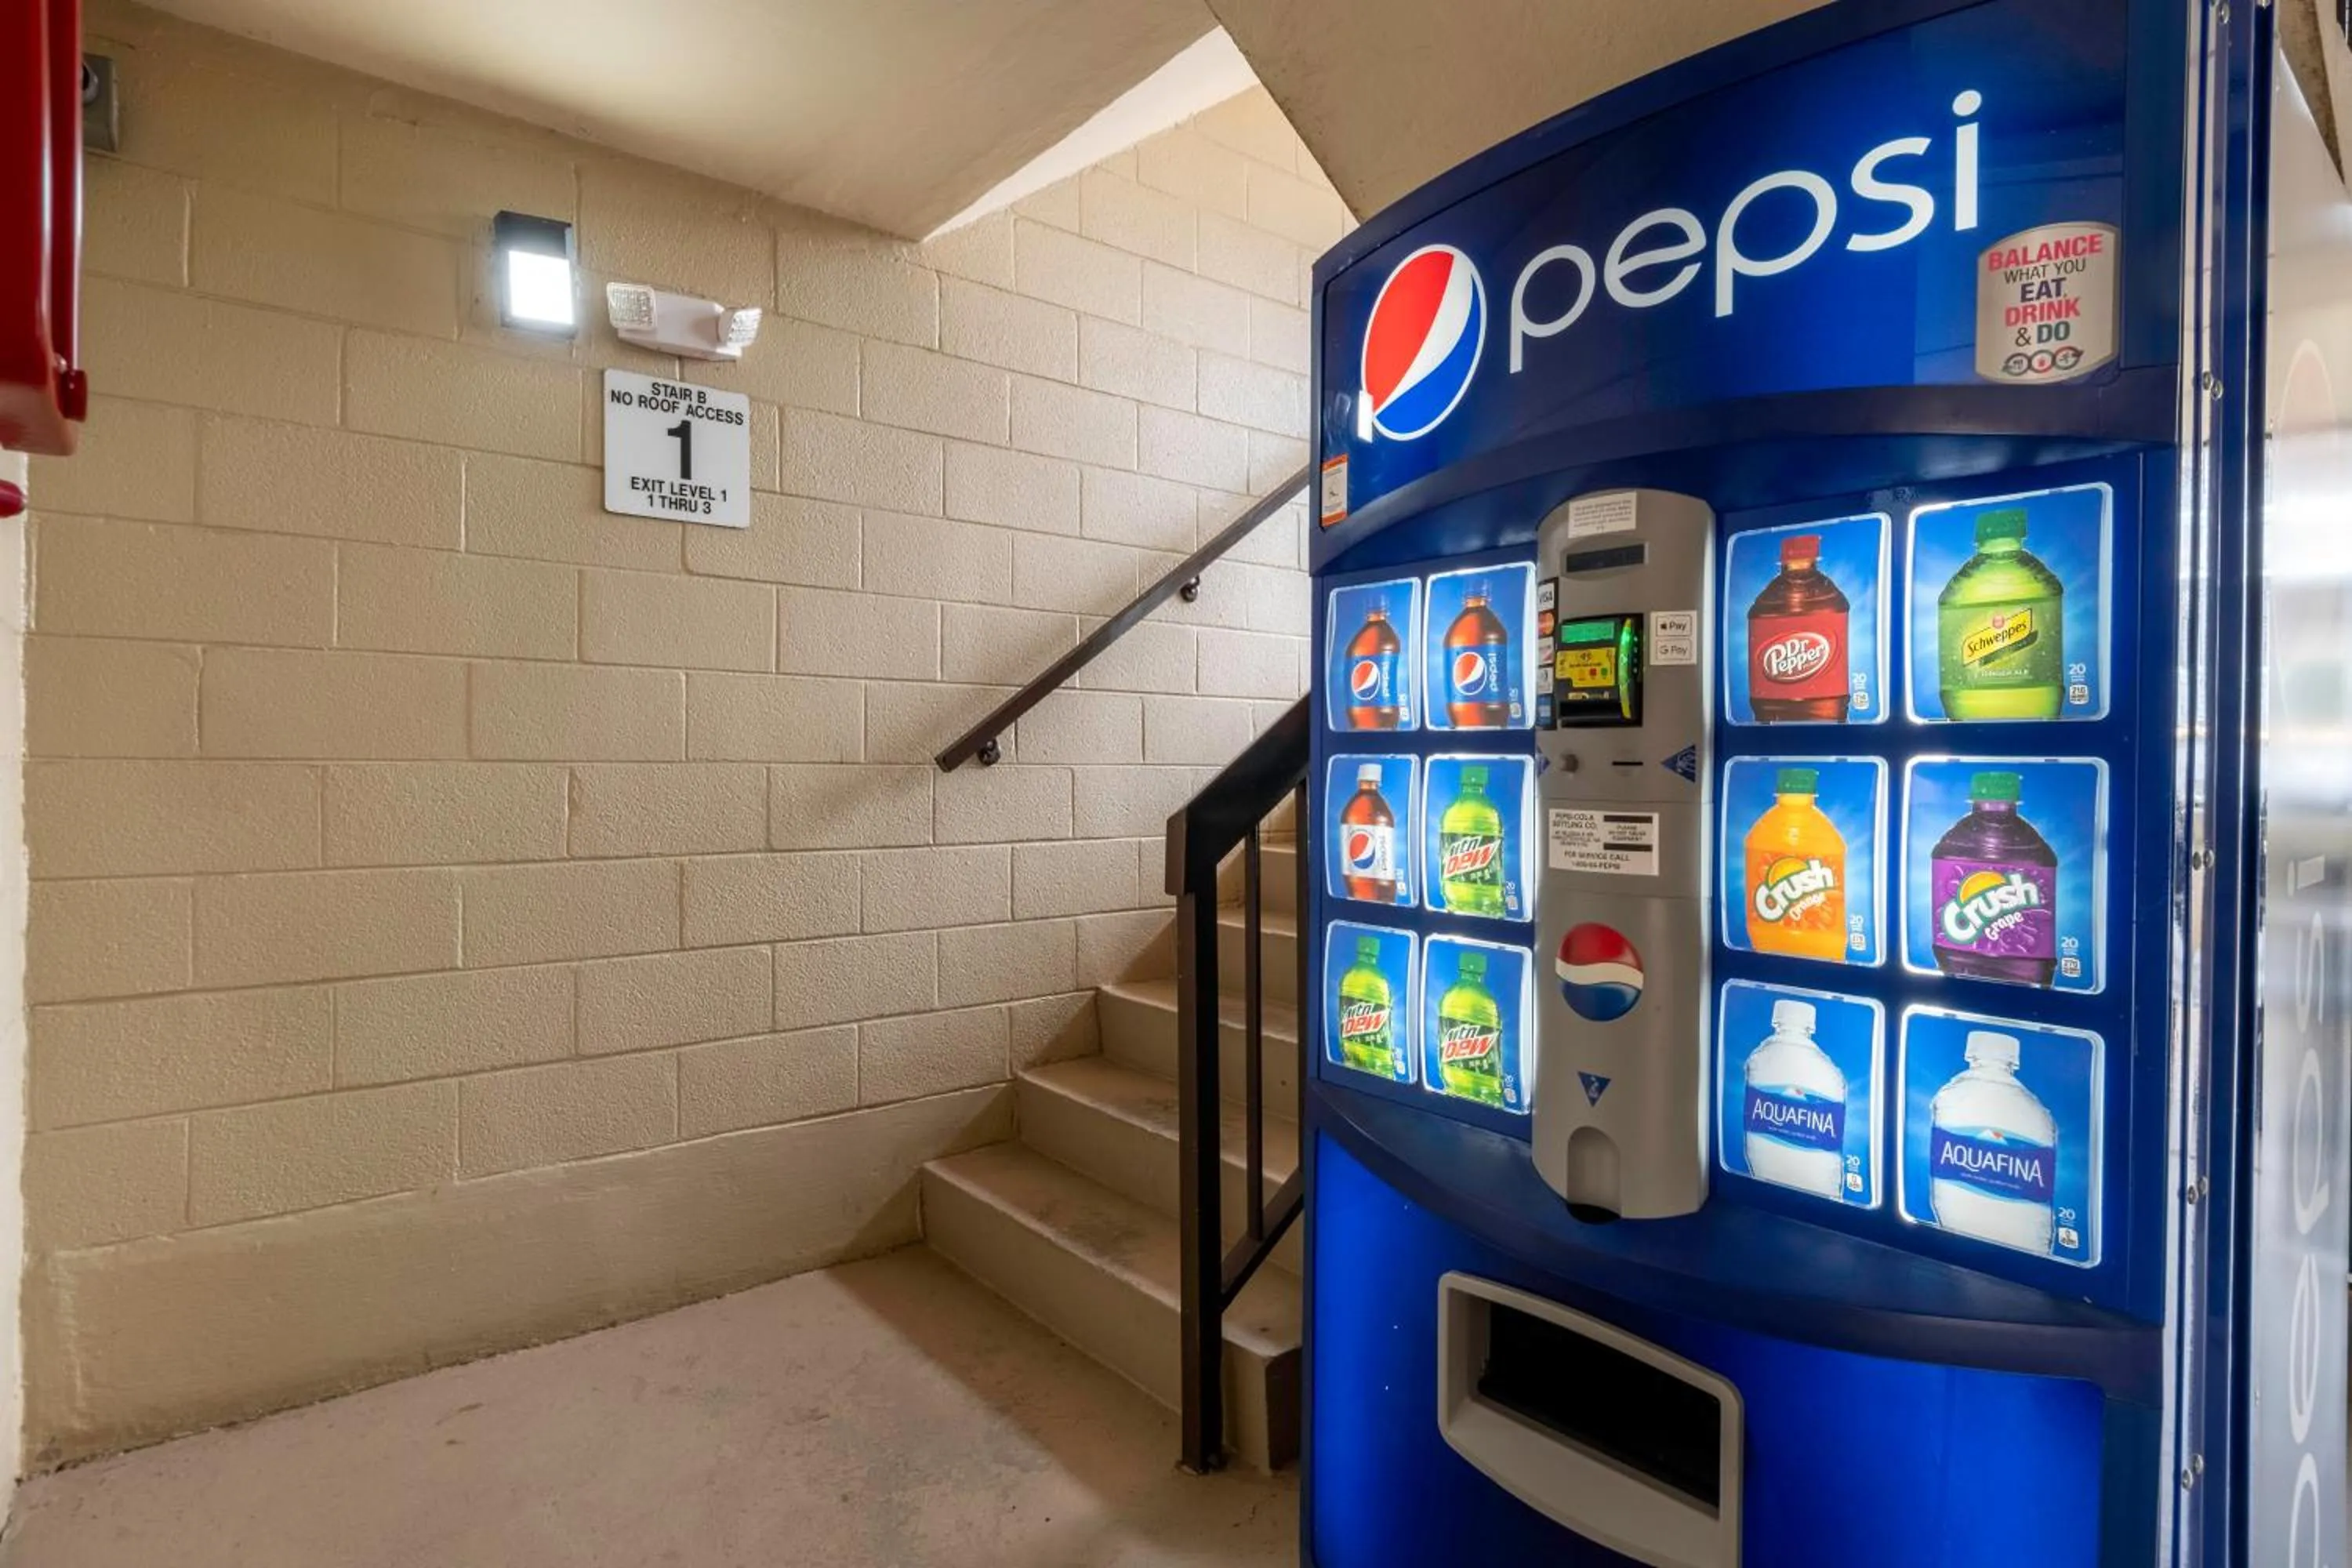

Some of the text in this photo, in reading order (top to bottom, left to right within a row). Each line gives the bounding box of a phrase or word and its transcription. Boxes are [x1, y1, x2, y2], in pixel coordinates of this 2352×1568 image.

[1509, 89, 1981, 373] pepsi
[1987, 234, 2103, 271] BALANCE
[2004, 258, 2086, 284] WHAT YOU
[2005, 296, 2081, 327] DRINK
[2016, 321, 2071, 347] & DO
[611, 390, 743, 426] NO ROOF ACCESS
[652, 382, 706, 404] STAIR B
[667, 420, 691, 480] 1
[631, 477, 727, 502] EXIT LEVEL 1
[648, 495, 712, 514] 1 THRU 3
[1786, 638, 1809, 656] Dr
[1967, 620, 2027, 658] Schweppes
[1488, 653, 1498, 692] pepsi
[1772, 644, 1825, 676] Pepper
[2068, 663, 2086, 675] 20
[1755, 859, 1835, 921] Crush
[1944, 873, 2039, 941] Crush
[1984, 912, 2024, 941] Grape
[2061, 936, 2078, 948] 20
[1751, 1098, 1836, 1138] AQUAFINA
[1940, 1141, 2044, 1188] AQUAFINA
[2058, 1207, 2075, 1221] 20
